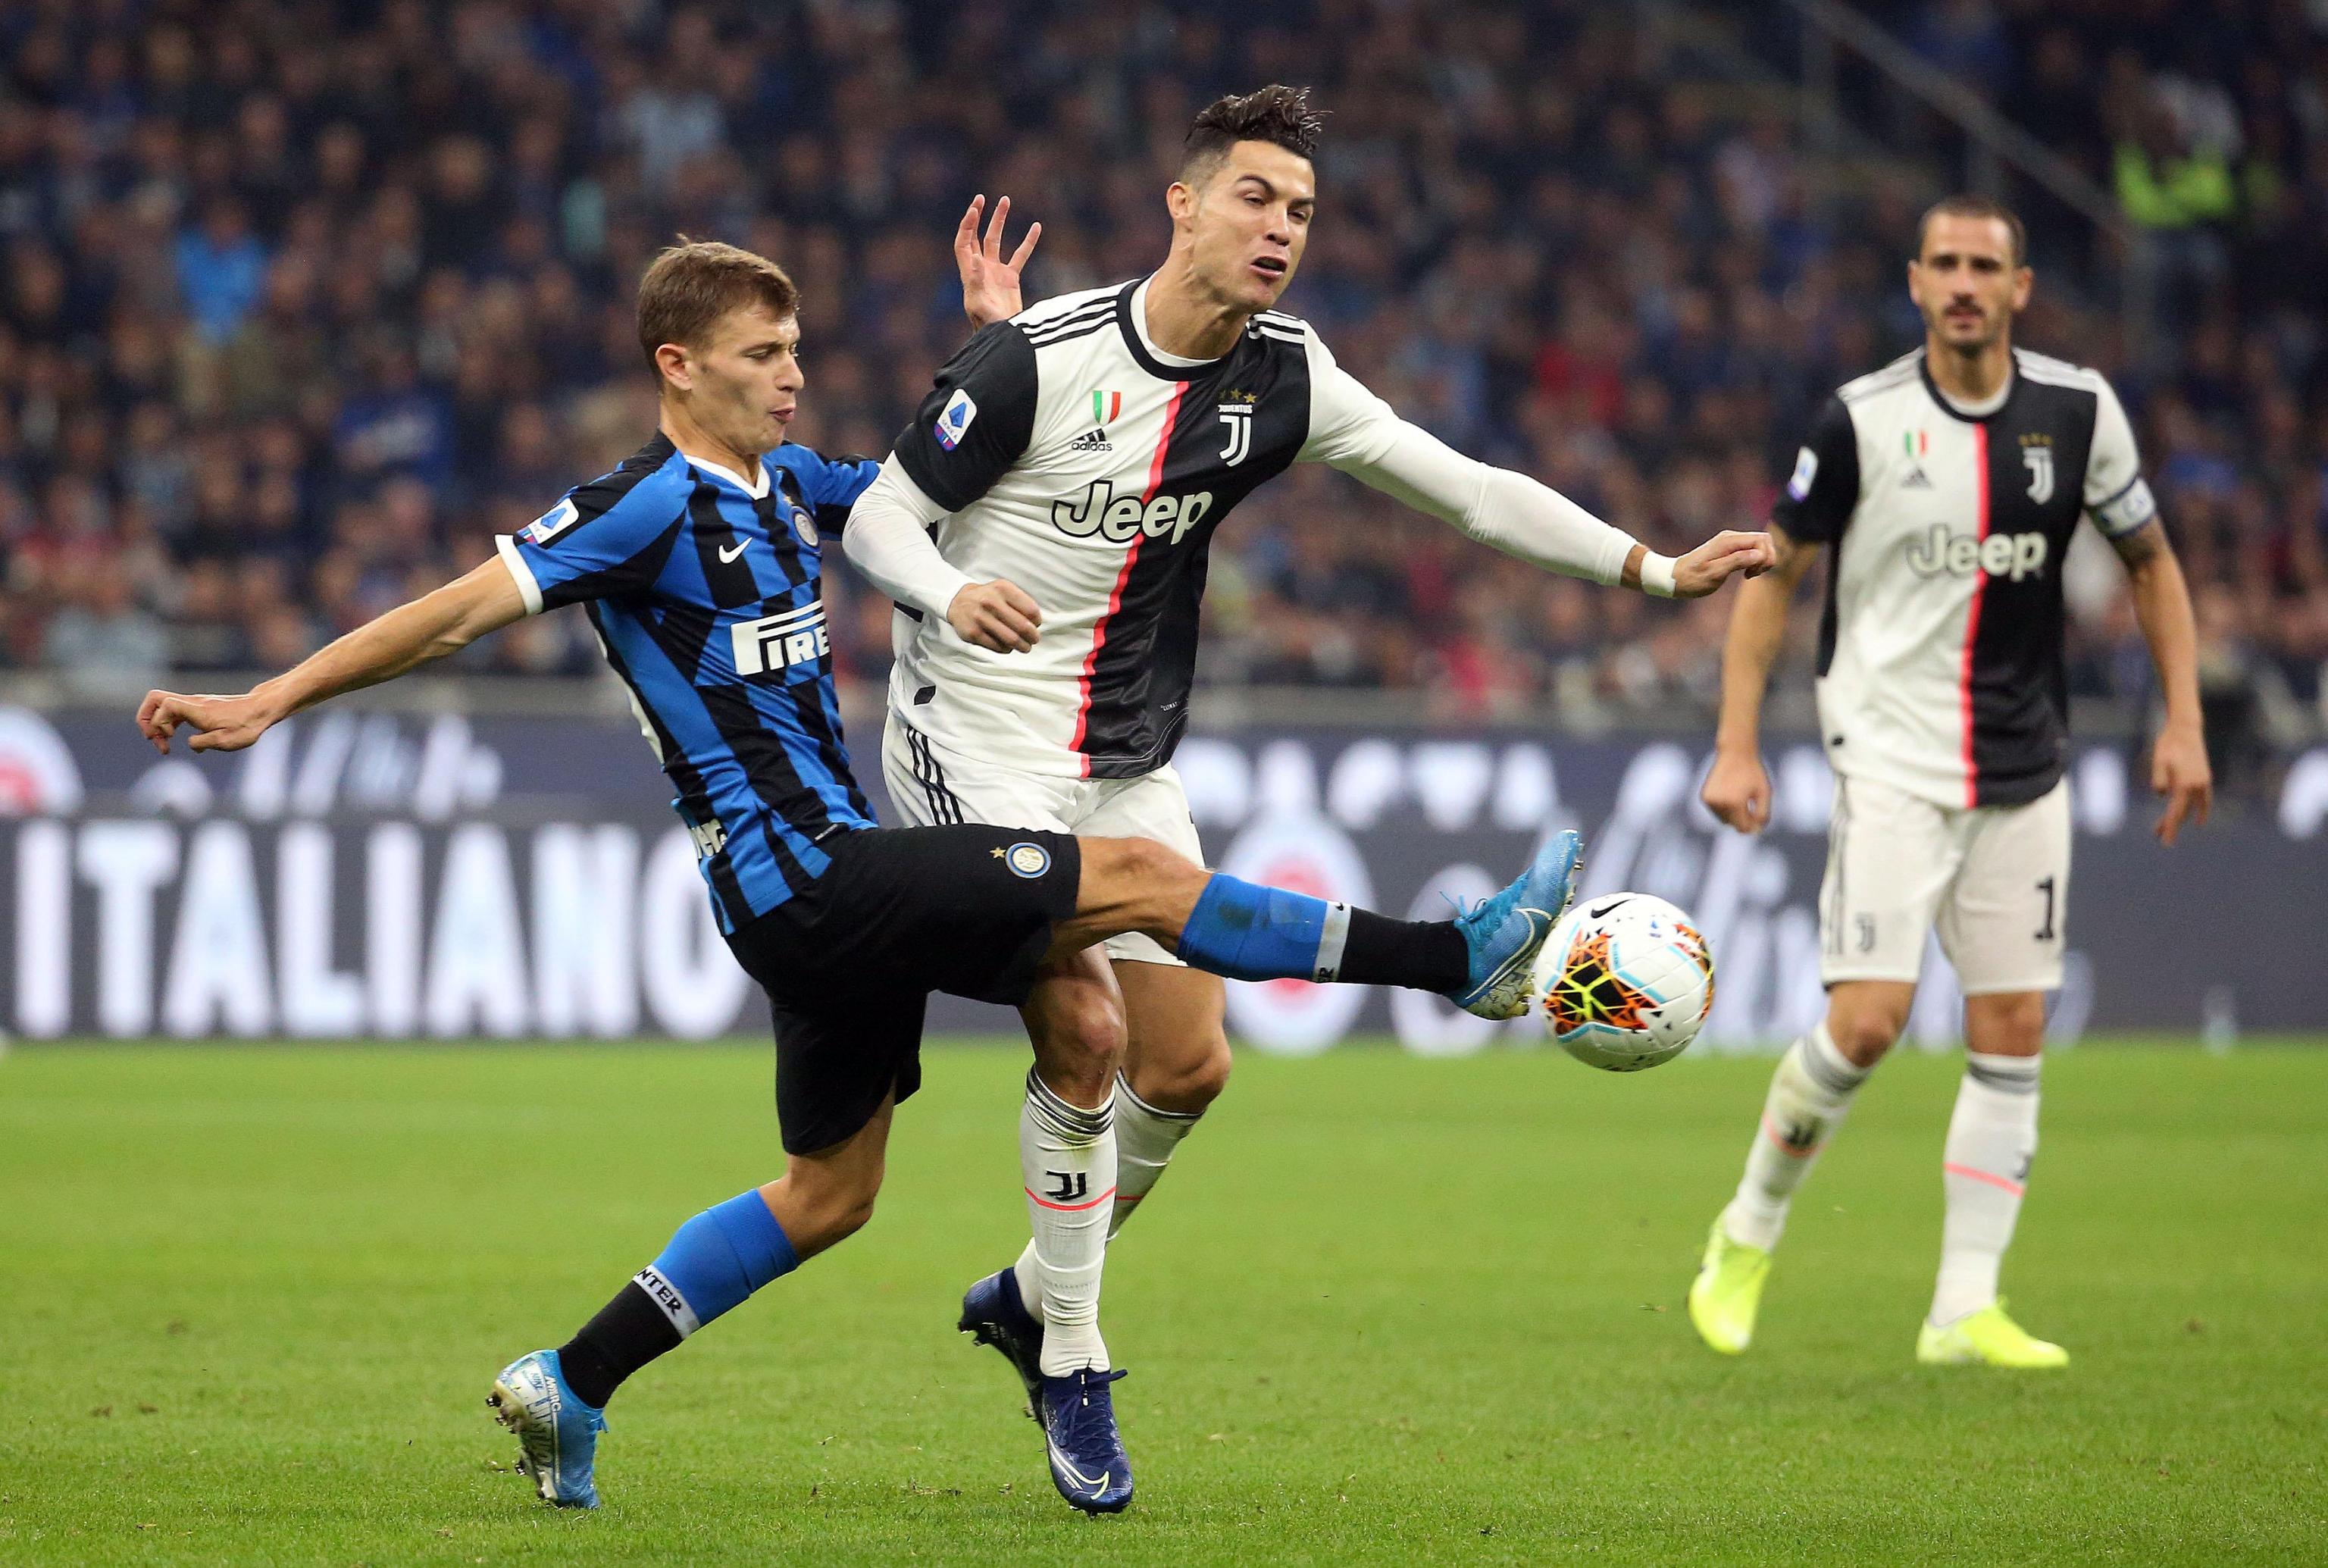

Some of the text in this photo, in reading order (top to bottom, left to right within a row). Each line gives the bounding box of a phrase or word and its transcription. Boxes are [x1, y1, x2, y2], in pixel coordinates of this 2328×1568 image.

[1071, 441, 1113, 452] adidas
[1052, 480, 1213, 545] Jeep
[1906, 522, 2047, 584] Jeep
[13, 818, 749, 1041] ITALIANO
